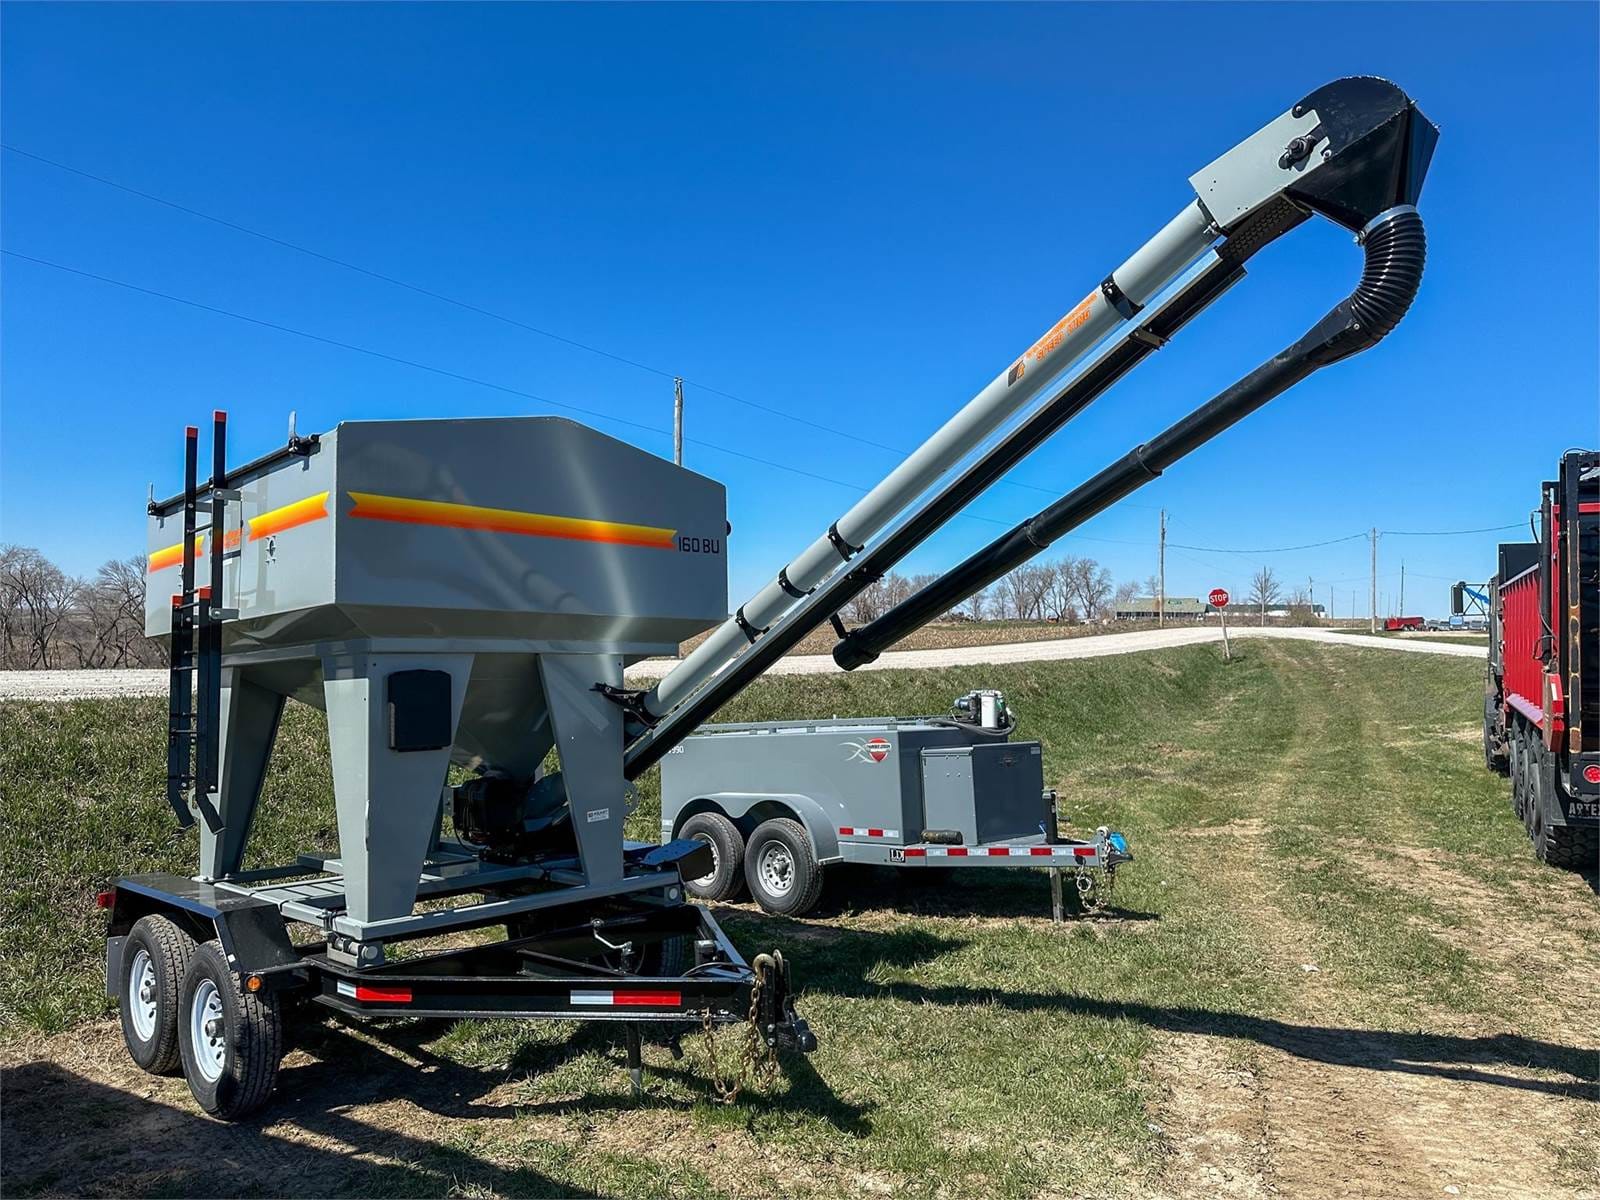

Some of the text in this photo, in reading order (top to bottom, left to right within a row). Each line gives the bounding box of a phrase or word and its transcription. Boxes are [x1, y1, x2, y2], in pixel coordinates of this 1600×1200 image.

[678, 536, 720, 554] 160 BU
[1209, 593, 1228, 603] STOP
[1568, 802, 1600, 816] ARTE
